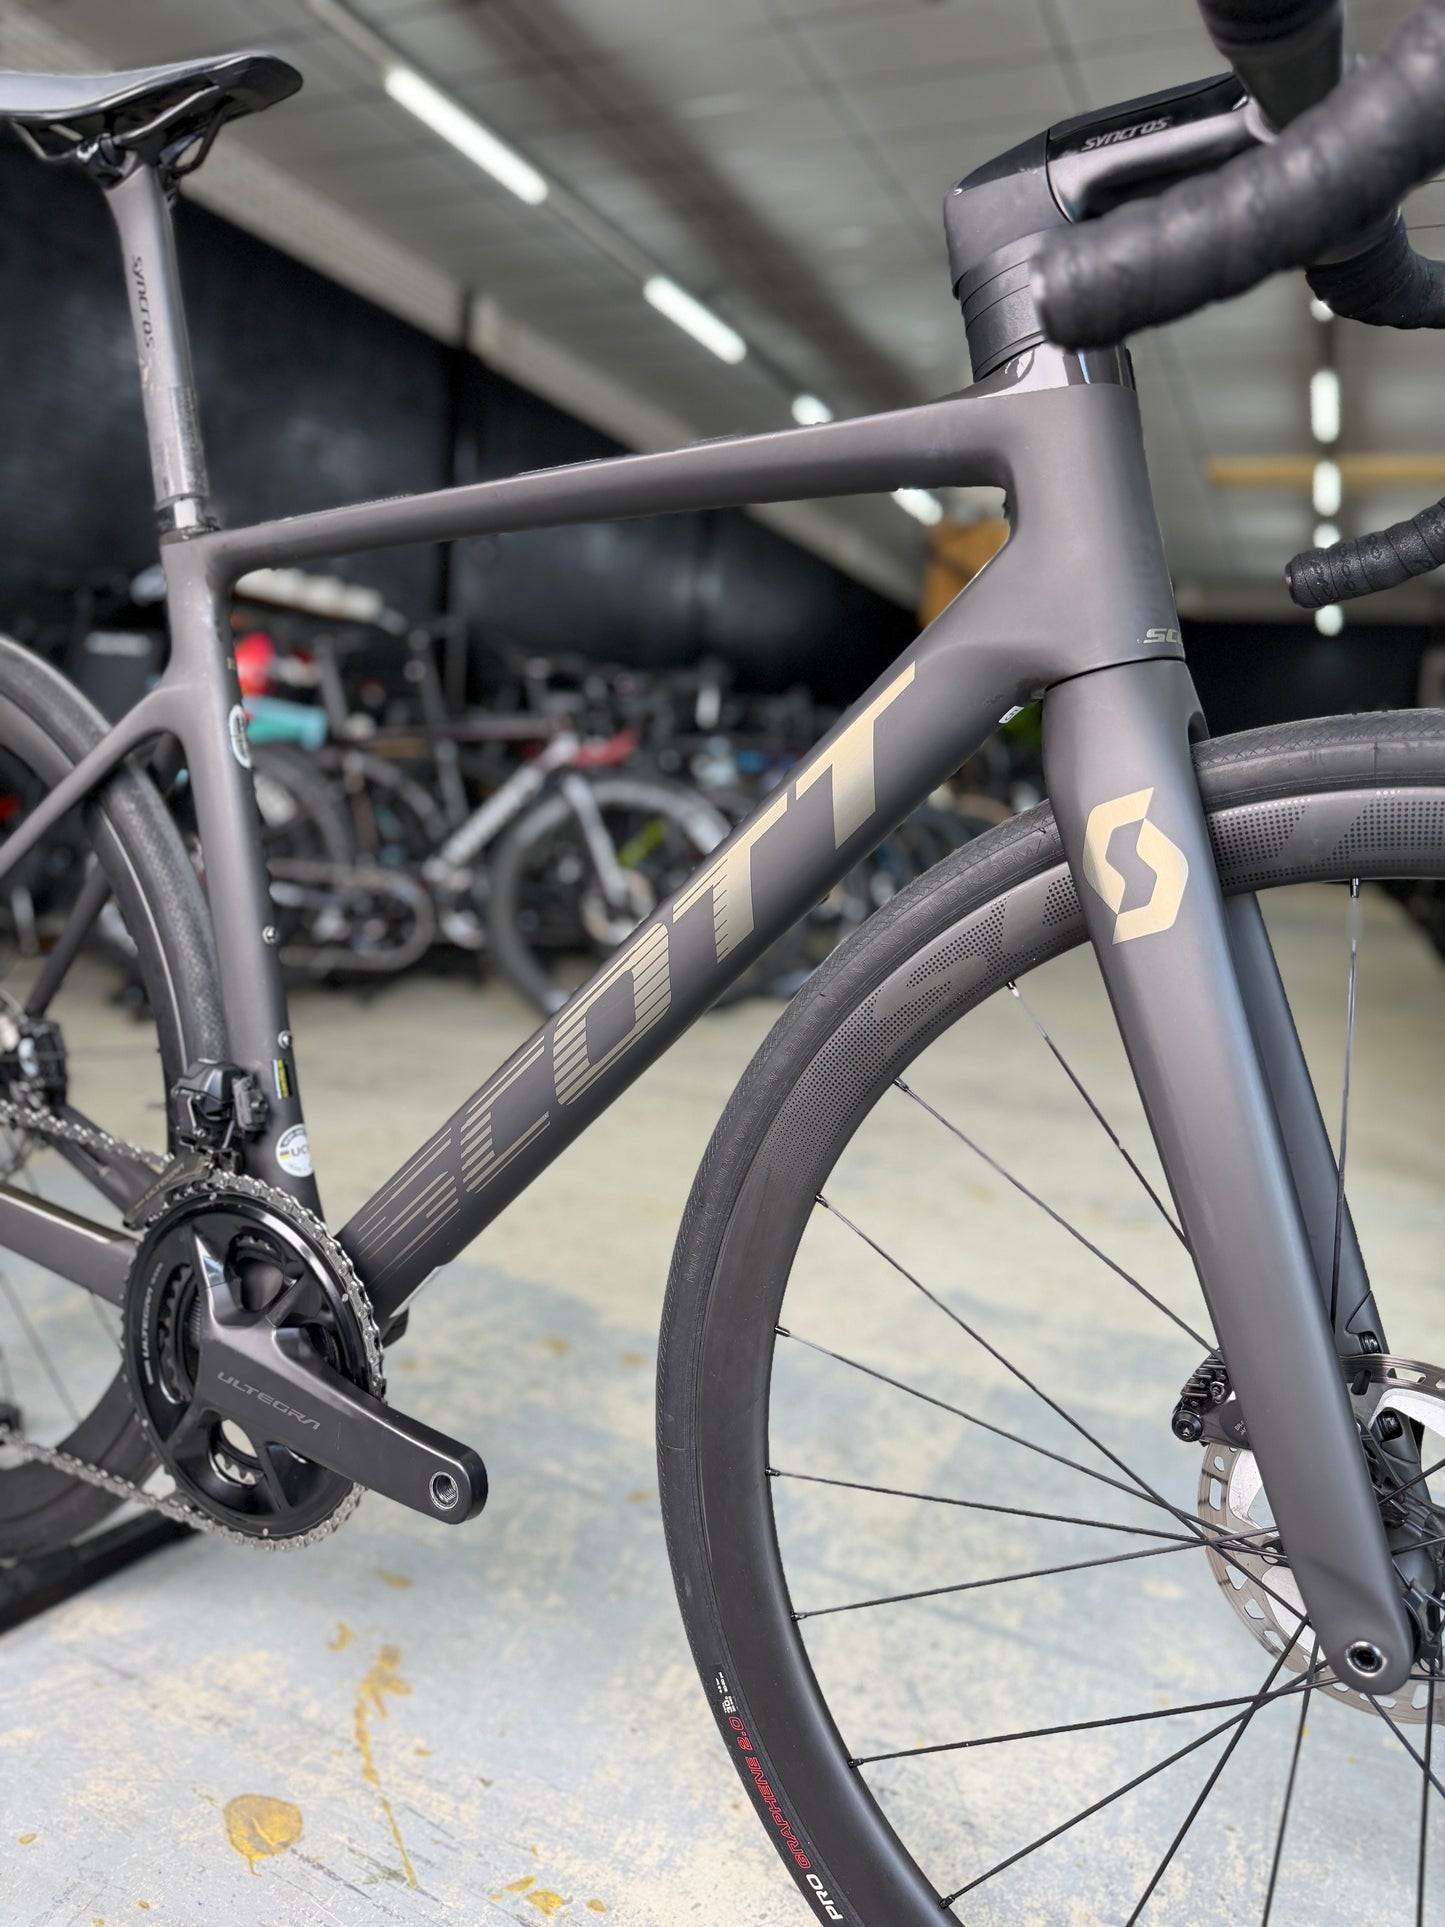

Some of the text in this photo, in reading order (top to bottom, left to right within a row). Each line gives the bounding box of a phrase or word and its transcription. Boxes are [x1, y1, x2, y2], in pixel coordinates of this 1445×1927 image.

[358, 660, 916, 1290] SCOTT
[217, 1371, 321, 1430] ULTEGRA
[728, 1715, 844, 1921] PRO GRAPHENE 2.0
